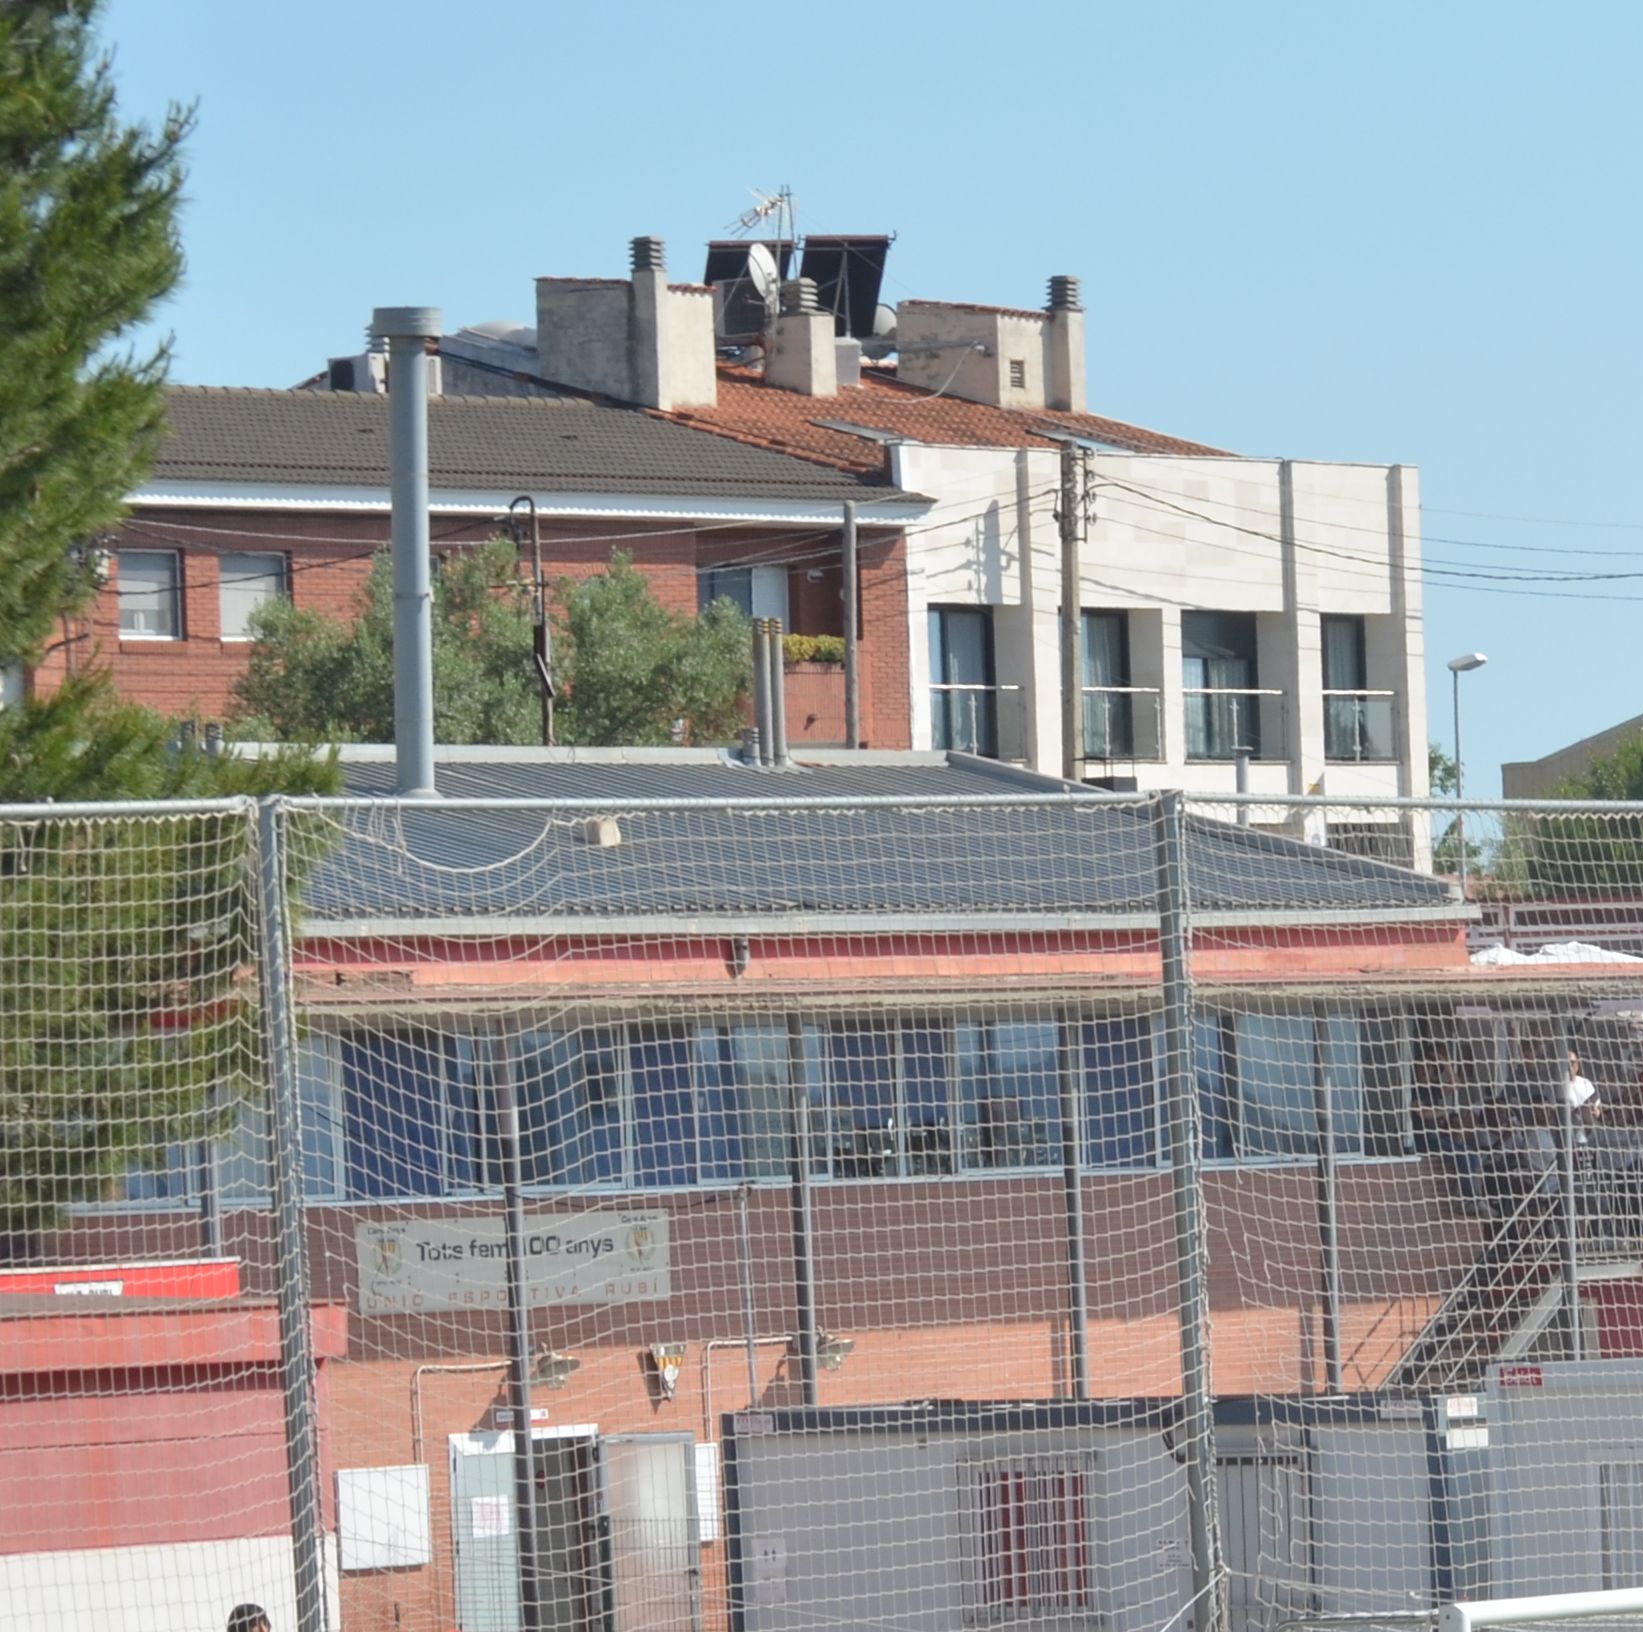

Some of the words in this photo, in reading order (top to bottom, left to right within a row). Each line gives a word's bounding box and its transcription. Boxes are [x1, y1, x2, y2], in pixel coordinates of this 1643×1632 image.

[416, 1240, 463, 1263] Tots
[470, 1237, 507, 1260] fem
[565, 1235, 614, 1264] anys
[449, 1284, 582, 1305] ESPOTIVA
